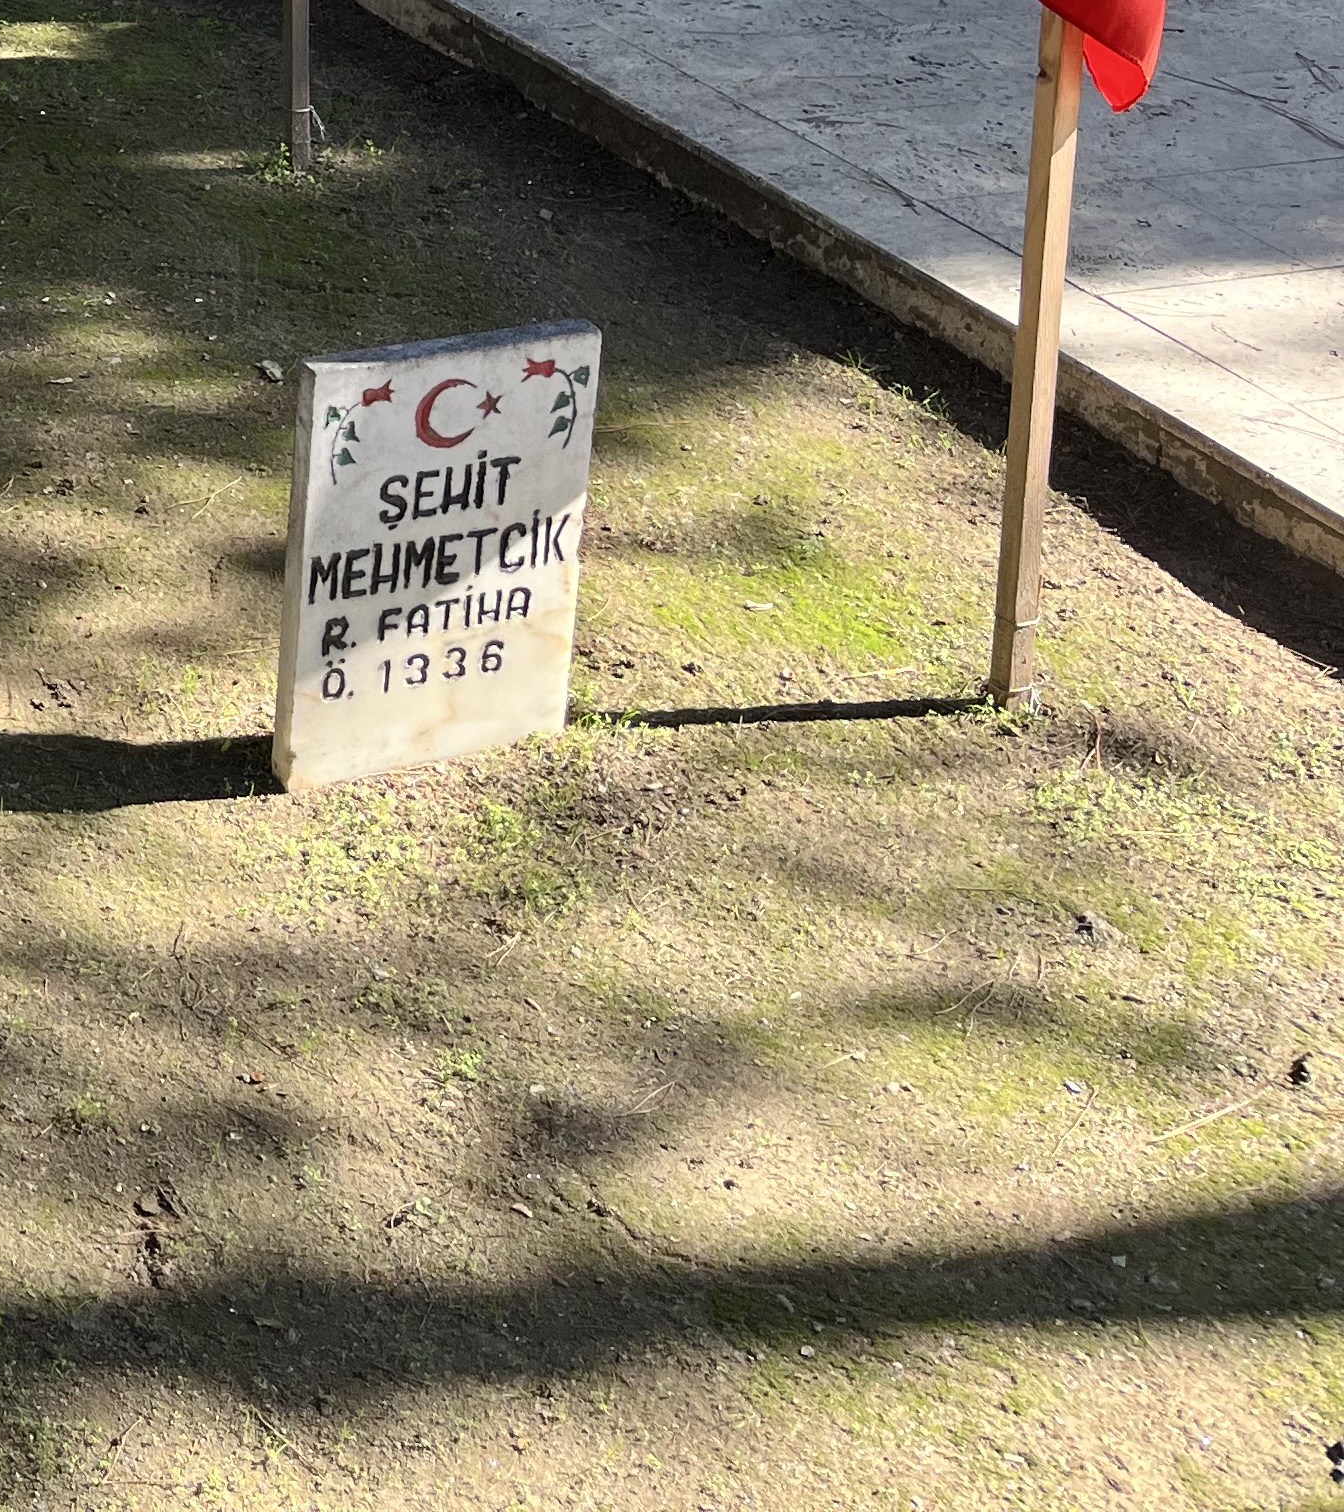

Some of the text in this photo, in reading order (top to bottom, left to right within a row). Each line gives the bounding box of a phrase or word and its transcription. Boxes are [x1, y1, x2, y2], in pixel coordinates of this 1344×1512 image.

[379, 449, 522, 531] ŞEHİT
[309, 509, 571, 605] MEHMETCİK
[322, 585, 532, 656] R. FATİHA
[322, 639, 505, 702] Ö. 1336
